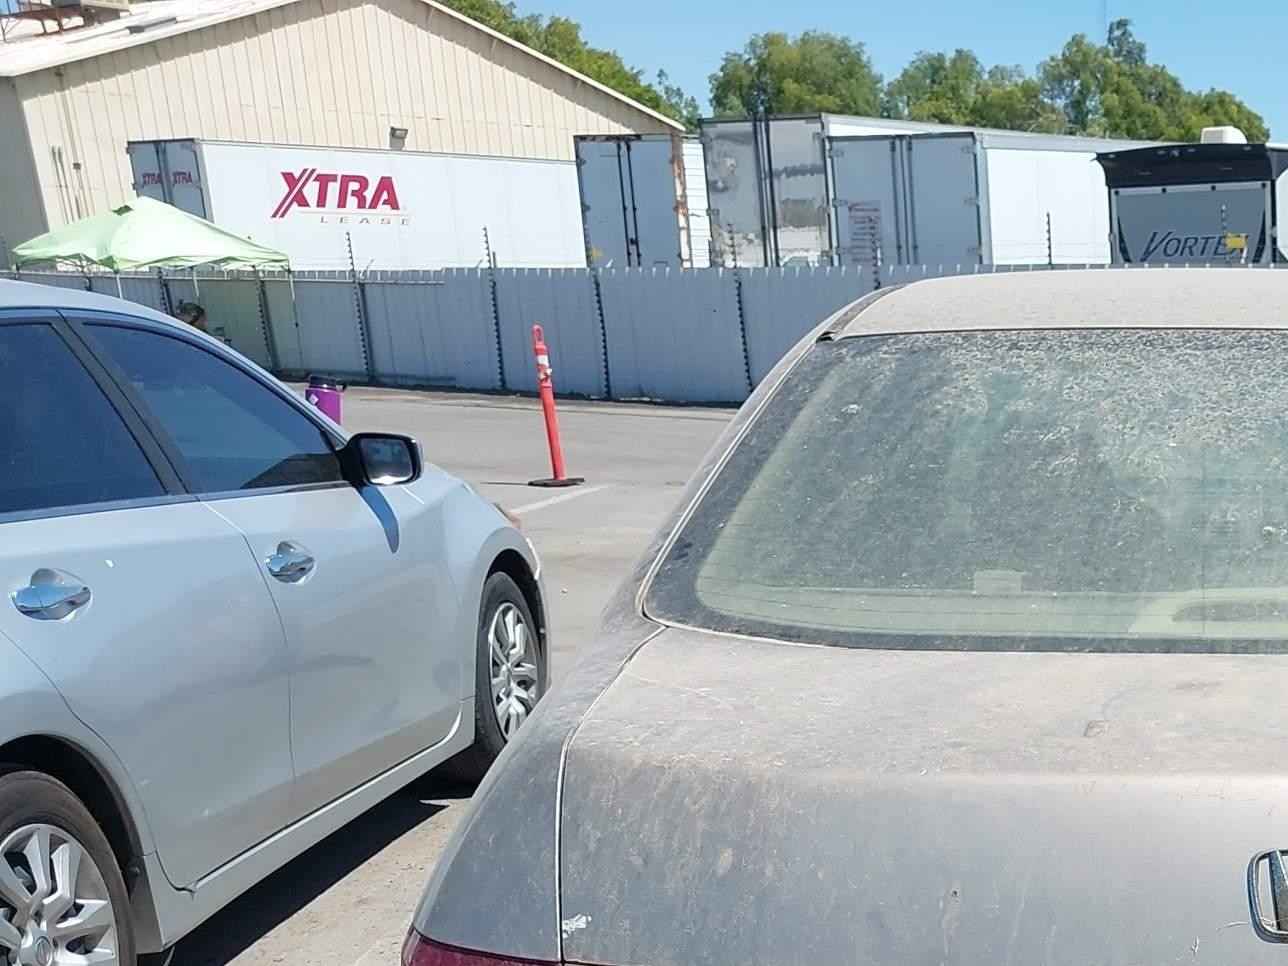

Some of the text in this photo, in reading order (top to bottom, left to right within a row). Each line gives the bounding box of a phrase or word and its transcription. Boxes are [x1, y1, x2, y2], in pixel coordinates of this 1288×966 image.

[142, 172, 162, 187] XTRA
[172, 171, 193, 187] XTRA
[271, 168, 400, 218] XTRA
[319, 215, 411, 226] LEASE
